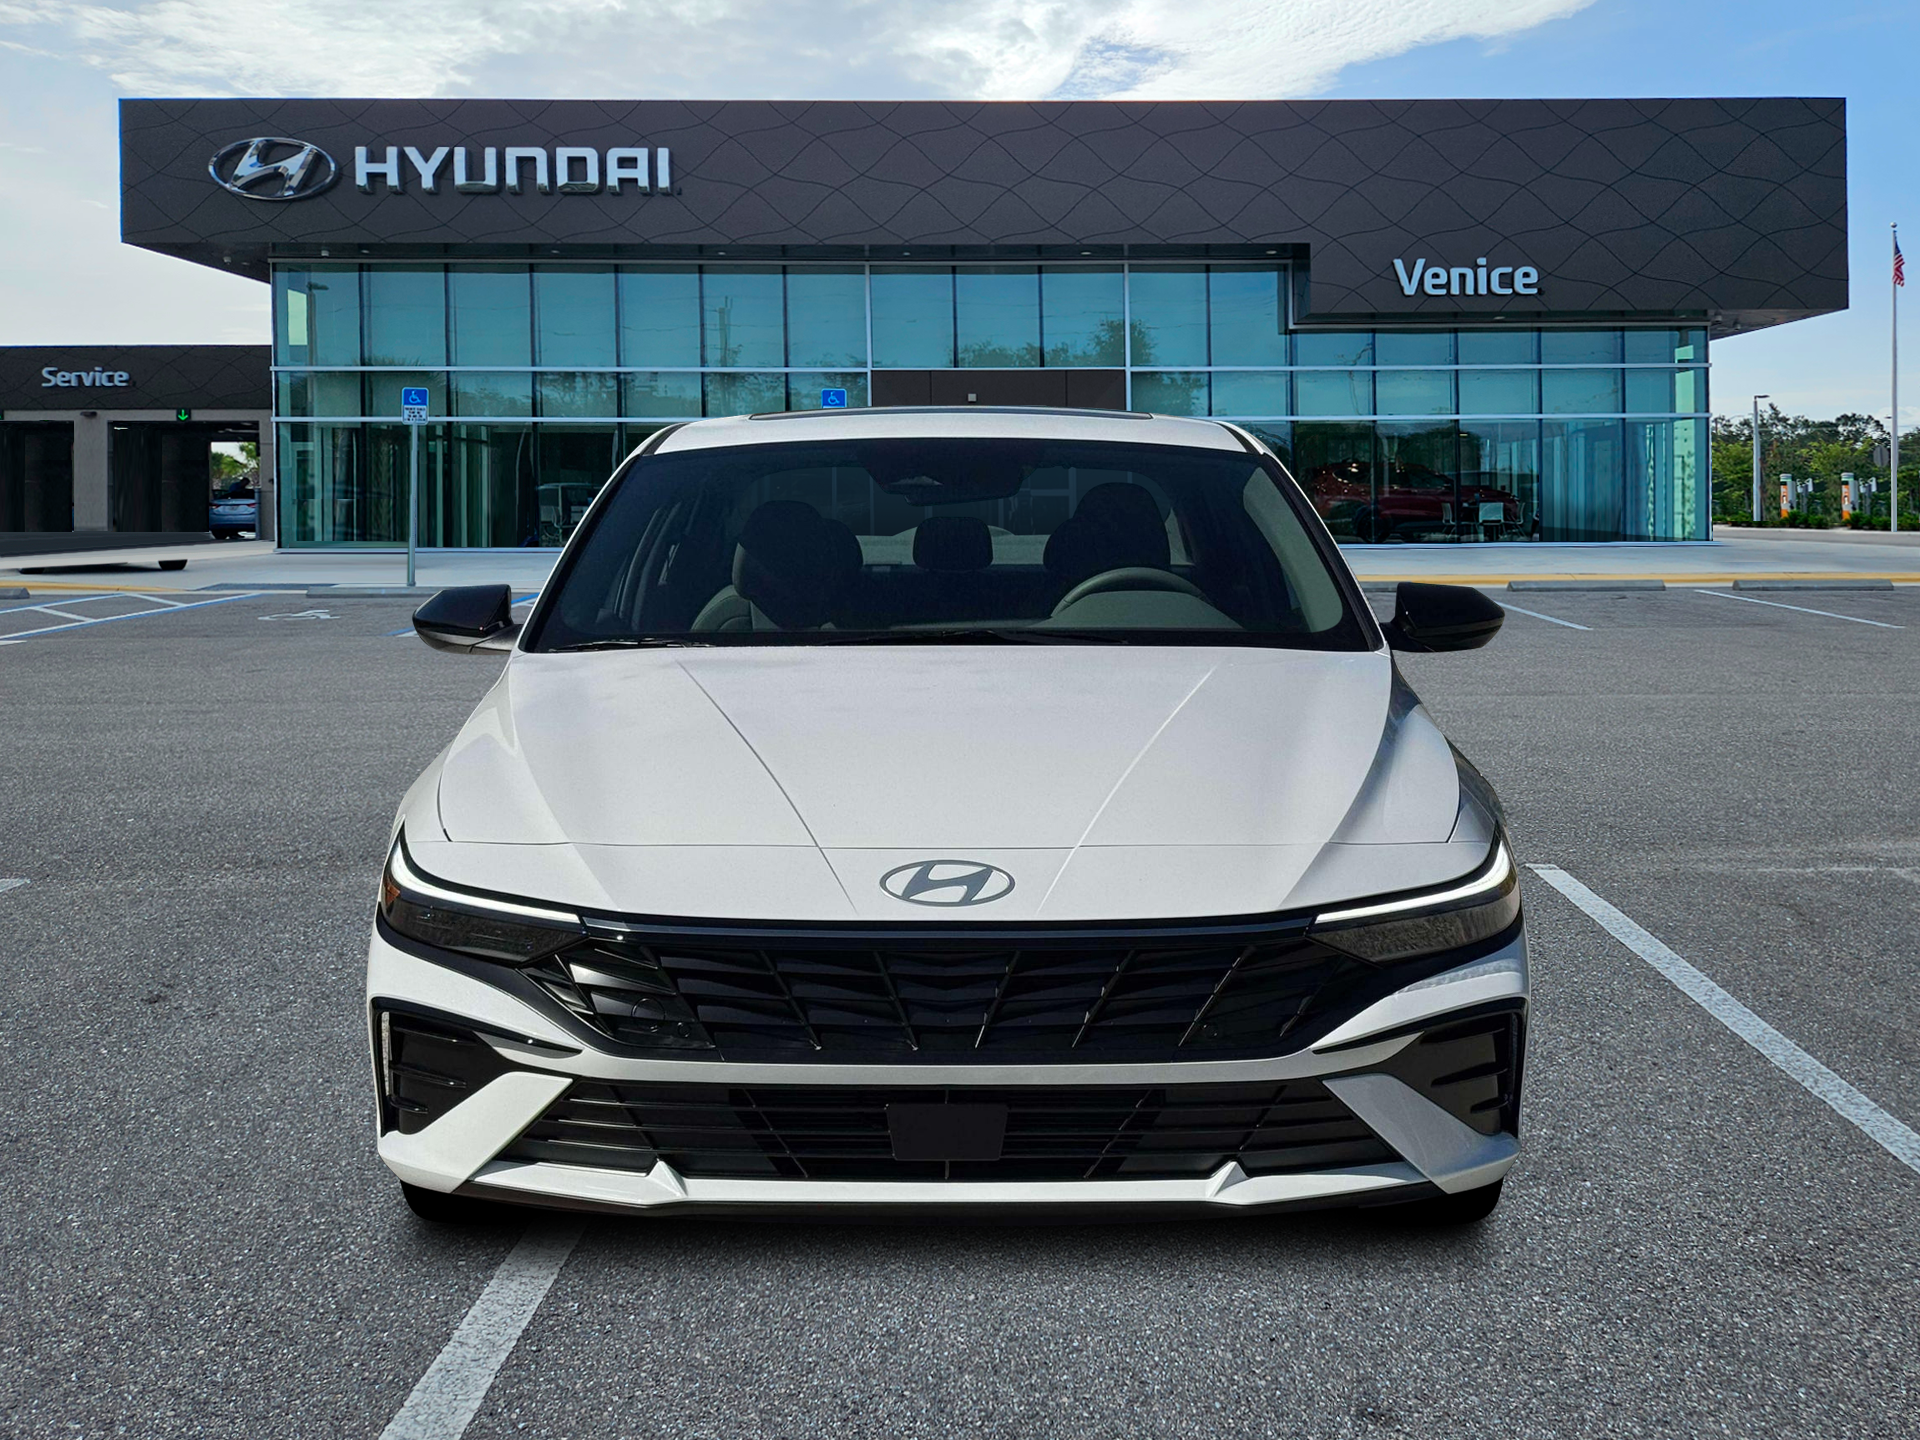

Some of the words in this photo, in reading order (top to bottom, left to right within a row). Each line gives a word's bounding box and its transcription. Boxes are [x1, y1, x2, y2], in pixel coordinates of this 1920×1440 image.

[355, 146, 671, 193] HYUNDAI
[1393, 257, 1539, 296] Venice
[41, 366, 130, 387] Service
